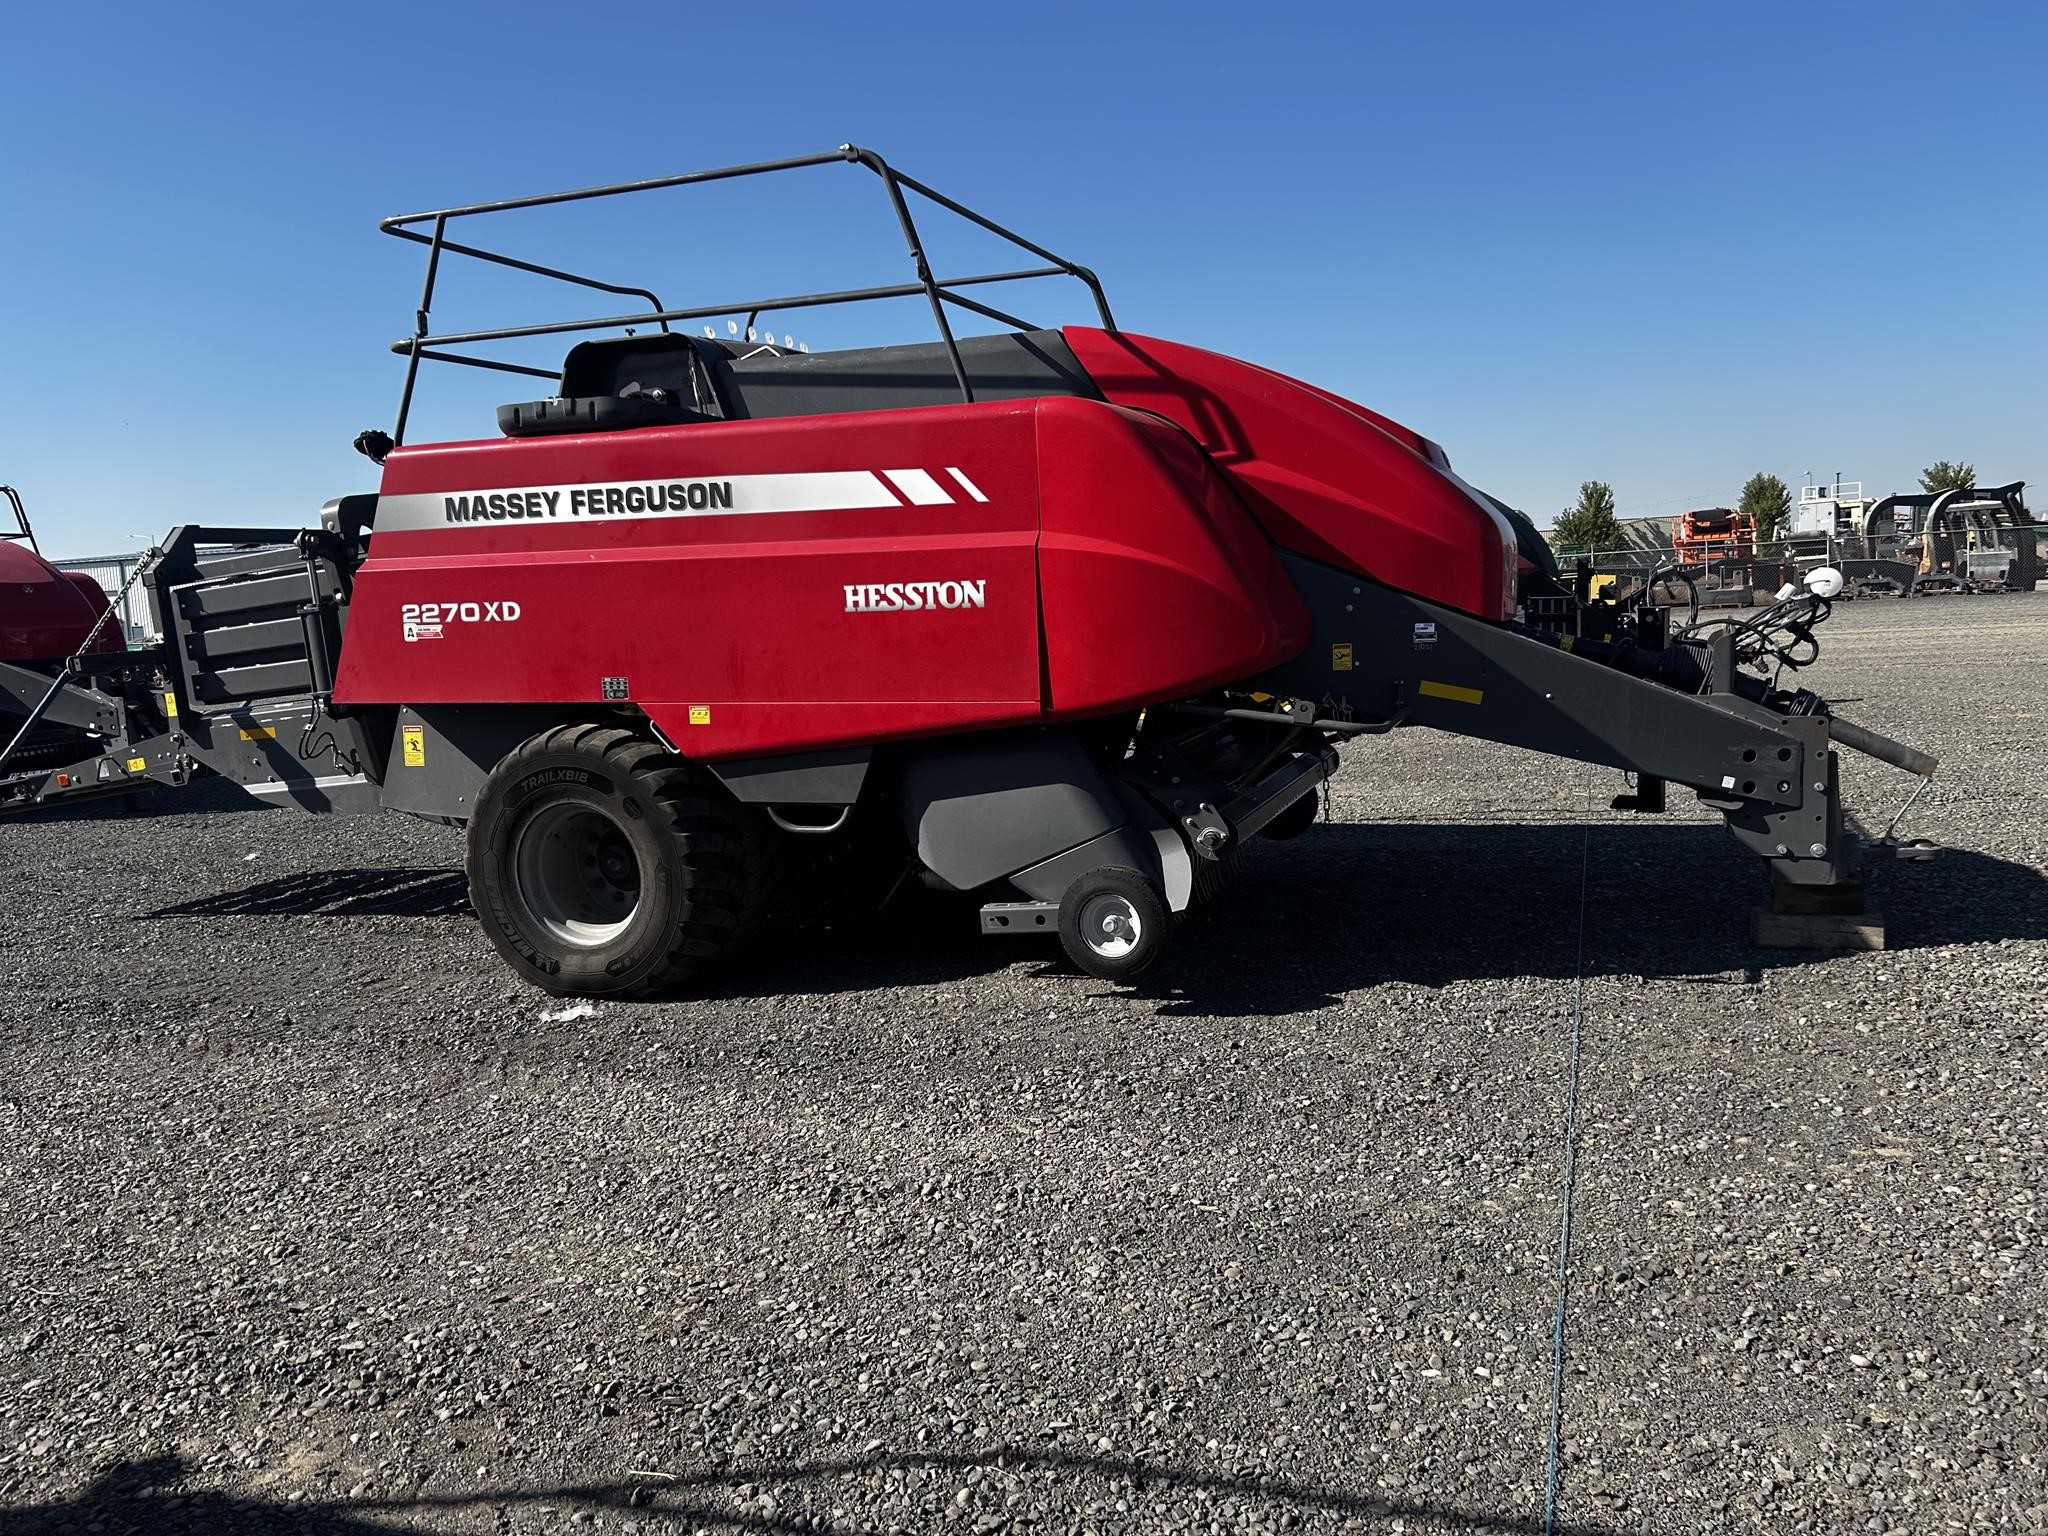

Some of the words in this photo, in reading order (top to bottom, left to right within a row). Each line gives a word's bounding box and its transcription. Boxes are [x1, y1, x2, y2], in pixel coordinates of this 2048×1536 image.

[445, 490, 561, 522] MASSEY
[570, 481, 734, 516] FERGUSON
[843, 579, 986, 613] HESSTON
[520, 769, 590, 793] TRAILXBIB
